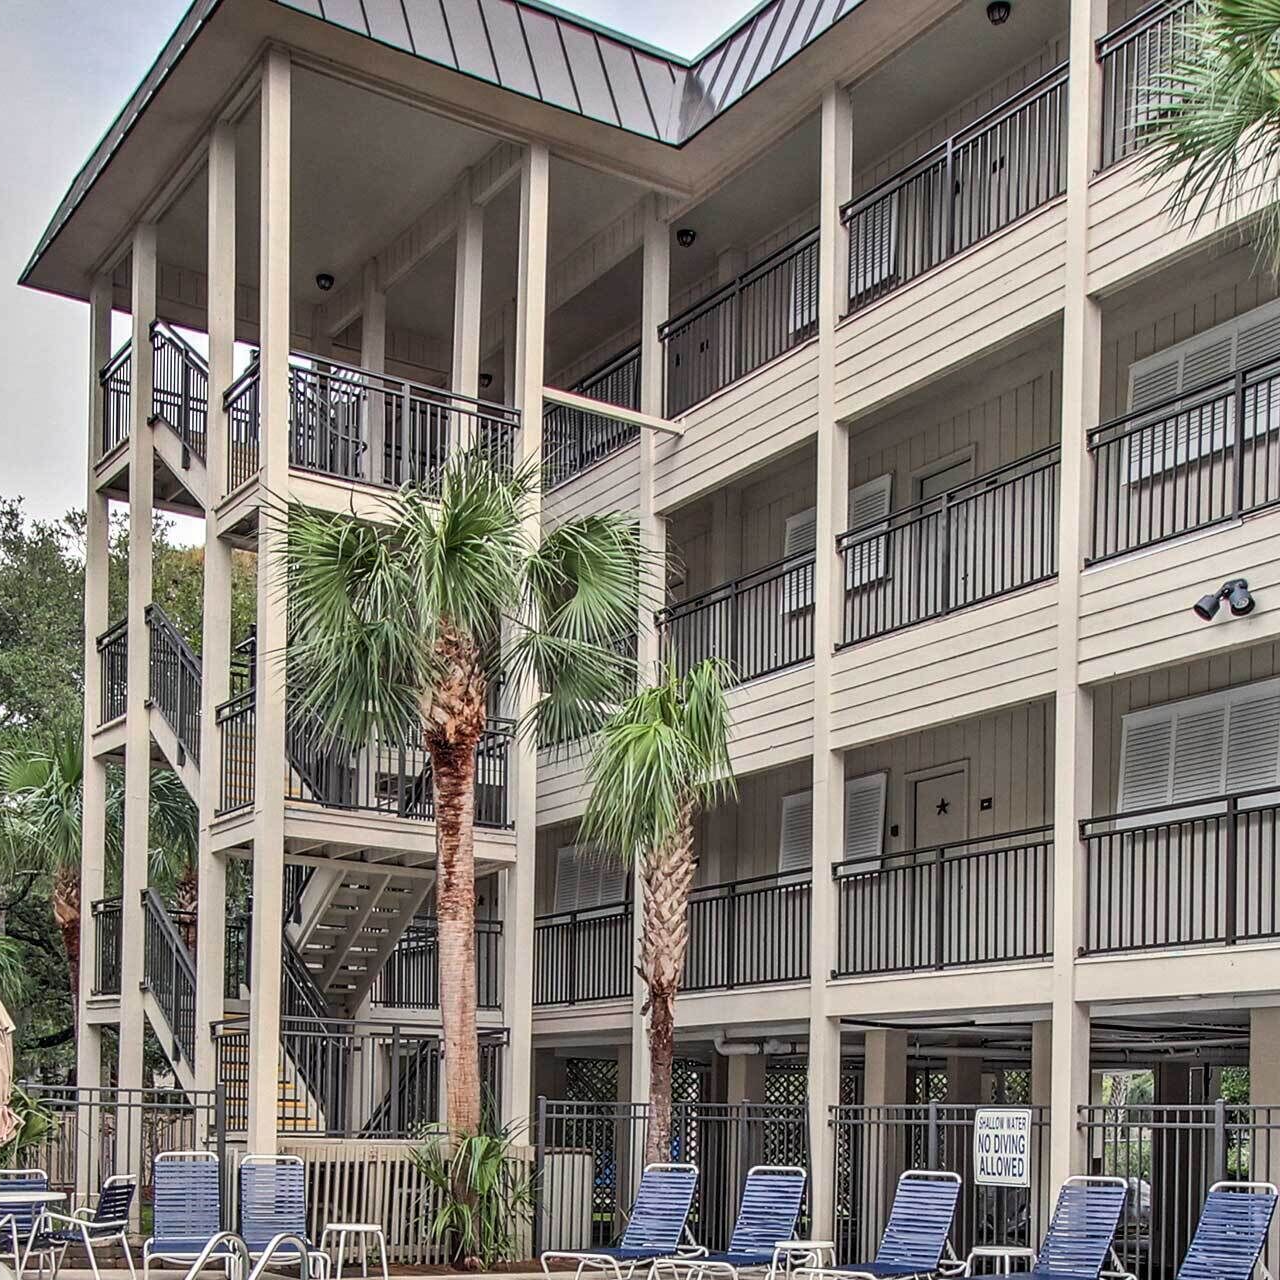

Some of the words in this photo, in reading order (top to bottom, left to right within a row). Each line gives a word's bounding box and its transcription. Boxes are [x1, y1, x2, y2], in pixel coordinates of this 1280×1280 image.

[978, 1116, 1004, 1130] SHALLOW
[1006, 1116, 1027, 1130] WATER
[978, 1133, 991, 1154] NO
[993, 1134, 1025, 1155] DIVING
[979, 1156, 1025, 1178] ALLOWED
